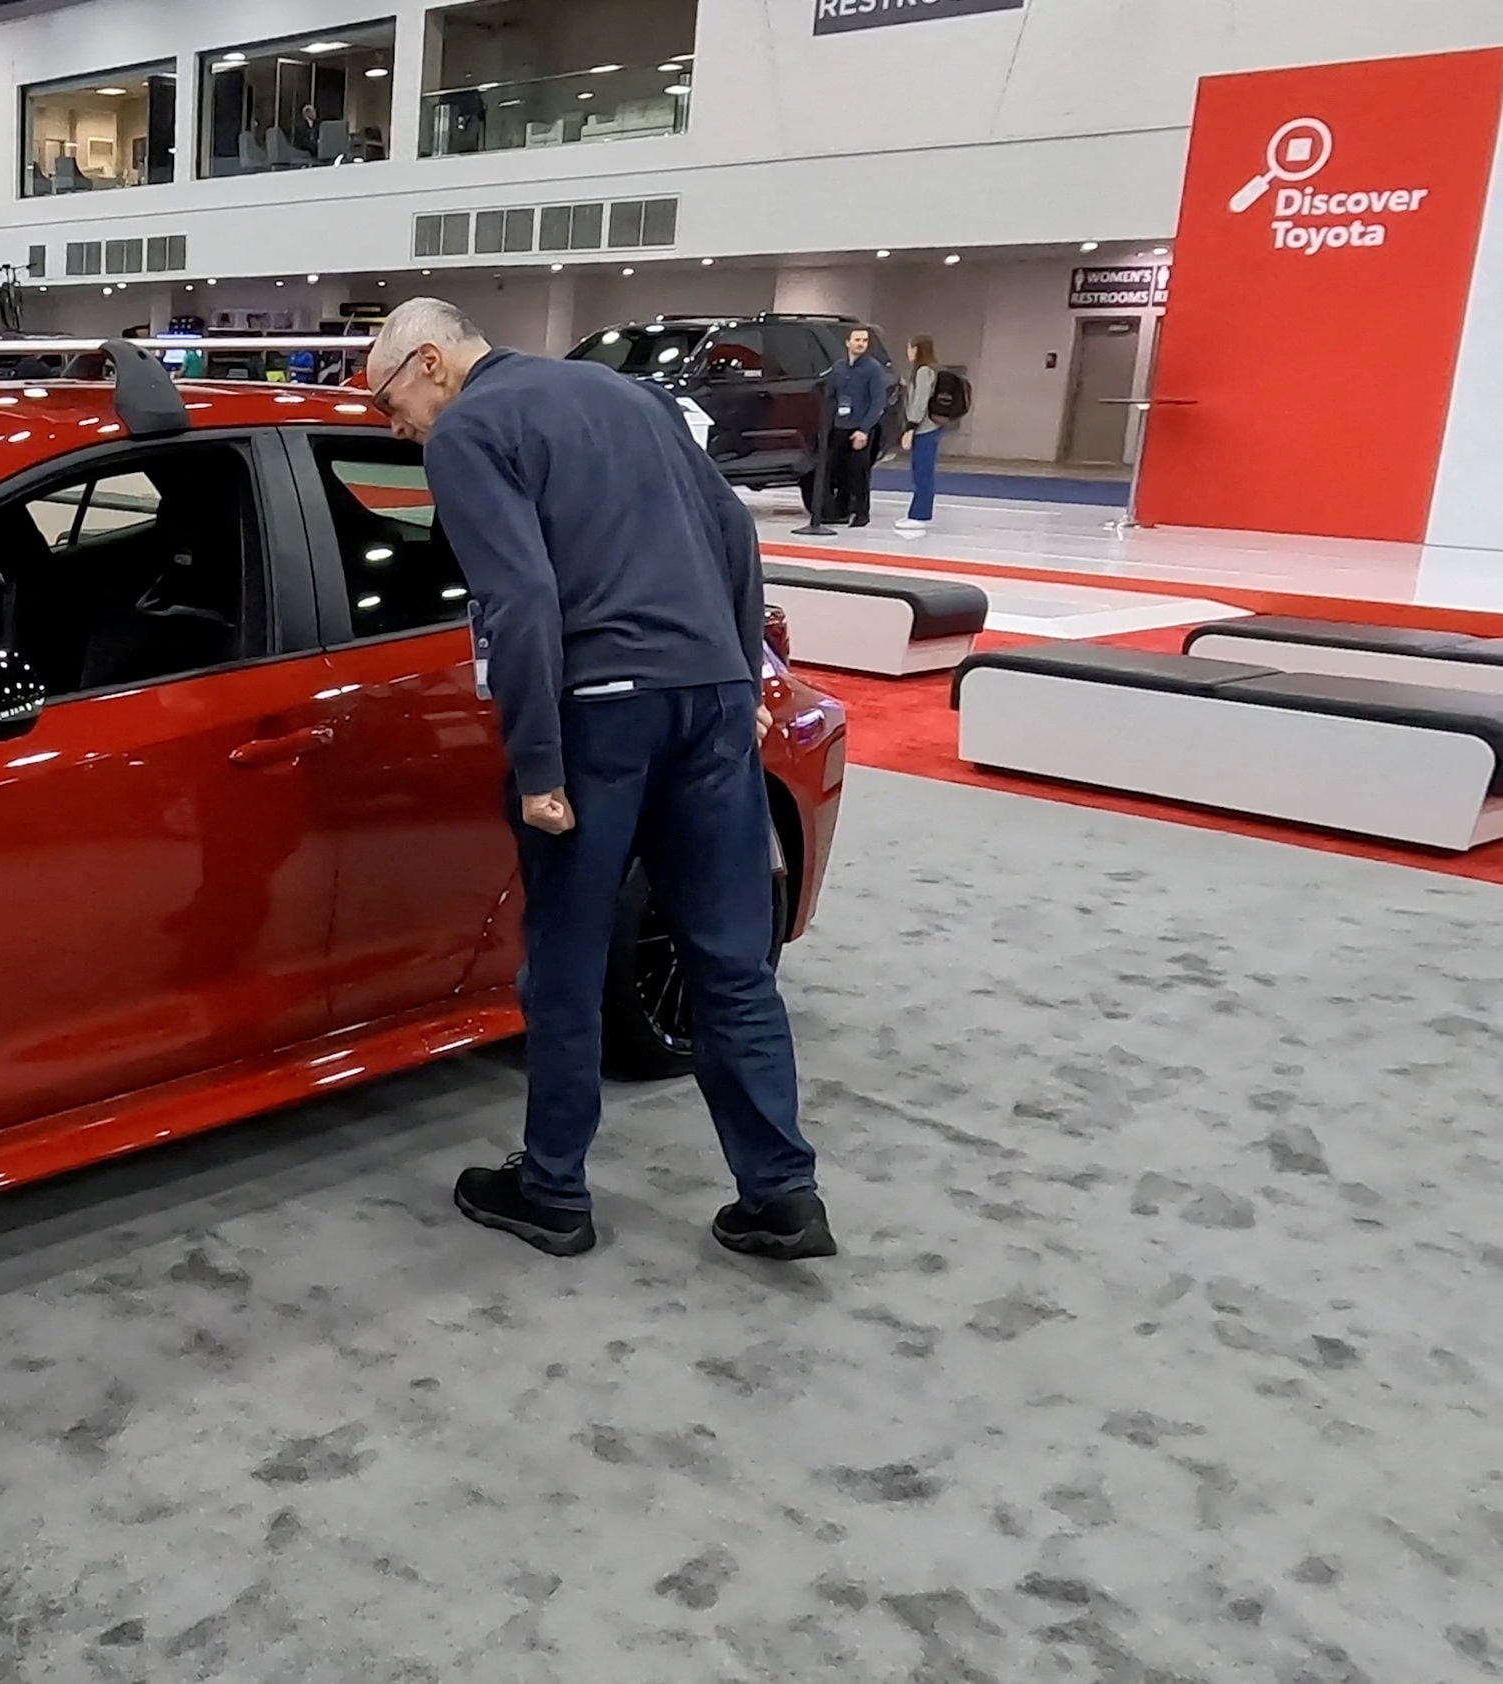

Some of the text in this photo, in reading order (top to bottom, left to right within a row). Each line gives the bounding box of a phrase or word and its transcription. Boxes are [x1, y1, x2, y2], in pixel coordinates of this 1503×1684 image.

[1275, 186, 1429, 217] Discover
[1271, 220, 1385, 256] Toyota
[1087, 269, 1152, 283] WOMEN'S
[1070, 290, 1149, 304] RESTROOMS
